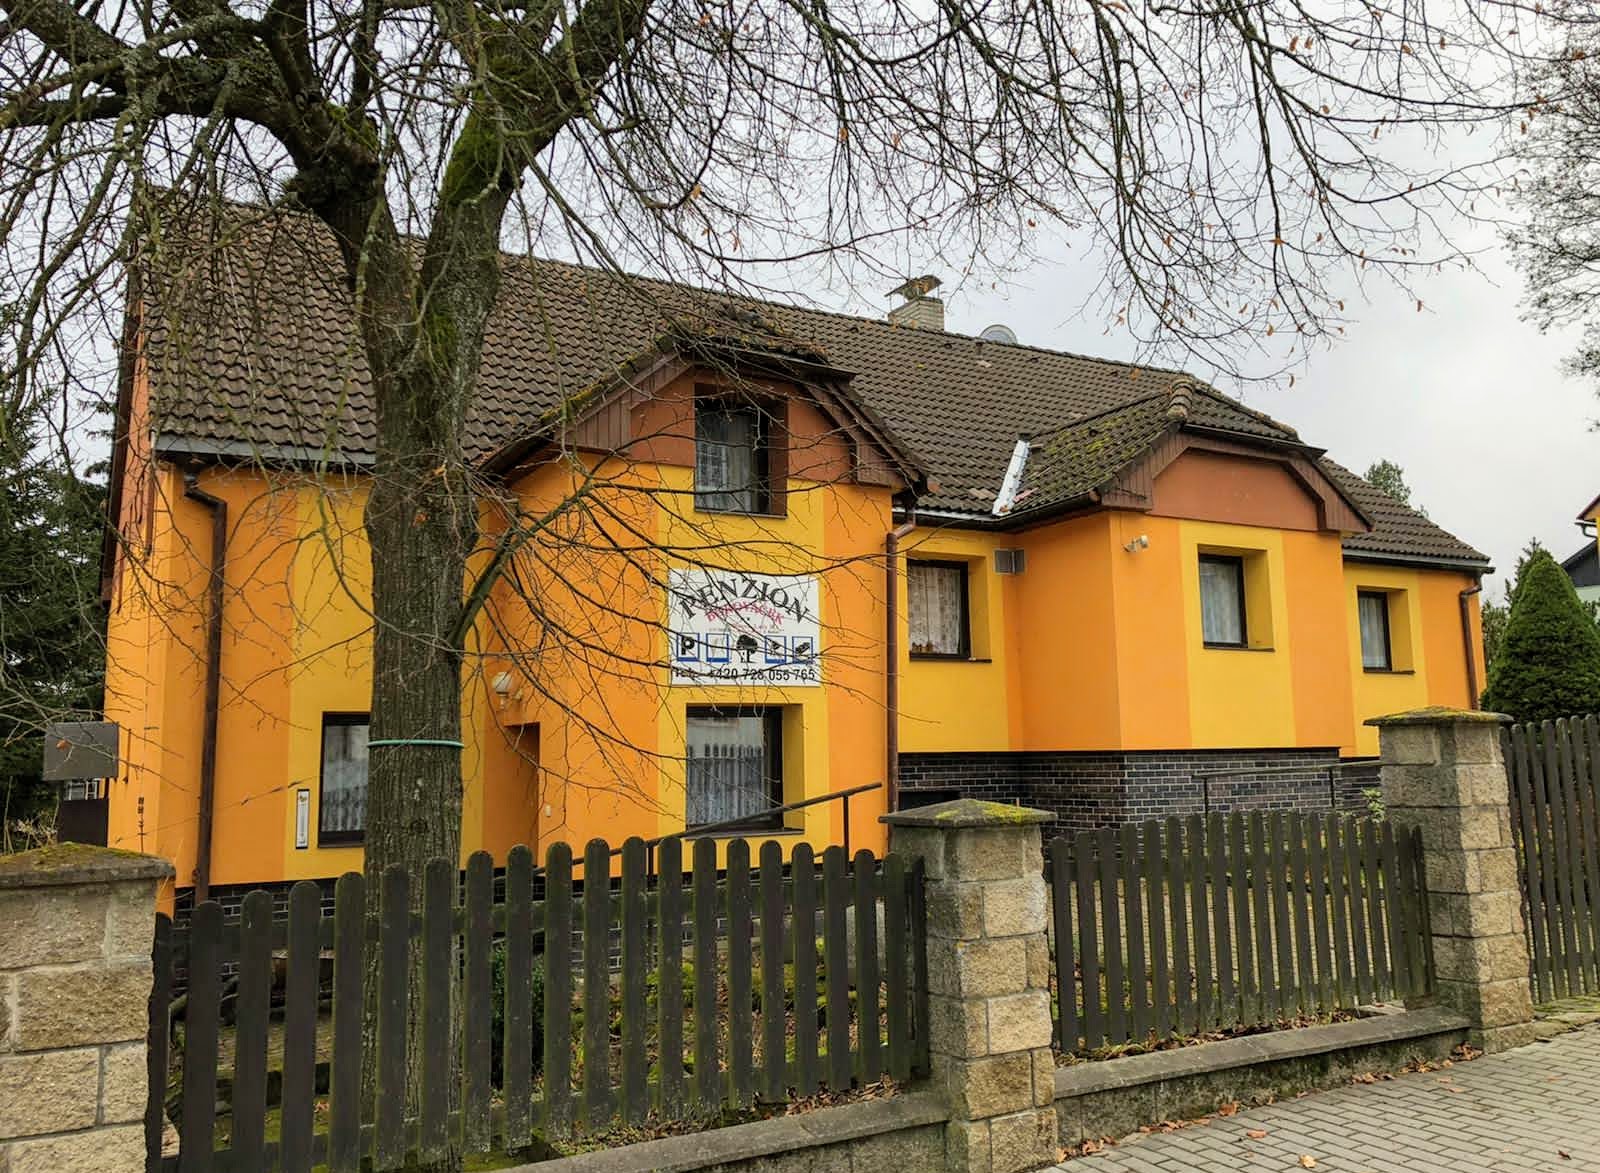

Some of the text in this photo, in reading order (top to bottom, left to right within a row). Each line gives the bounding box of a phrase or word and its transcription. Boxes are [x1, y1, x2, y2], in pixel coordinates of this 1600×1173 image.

[679, 578, 810, 623] PENZION
[681, 635, 695, 656] P
[742, 668, 764, 681] 728
[768, 668, 790, 681] 055
[793, 668, 815, 681] 765
